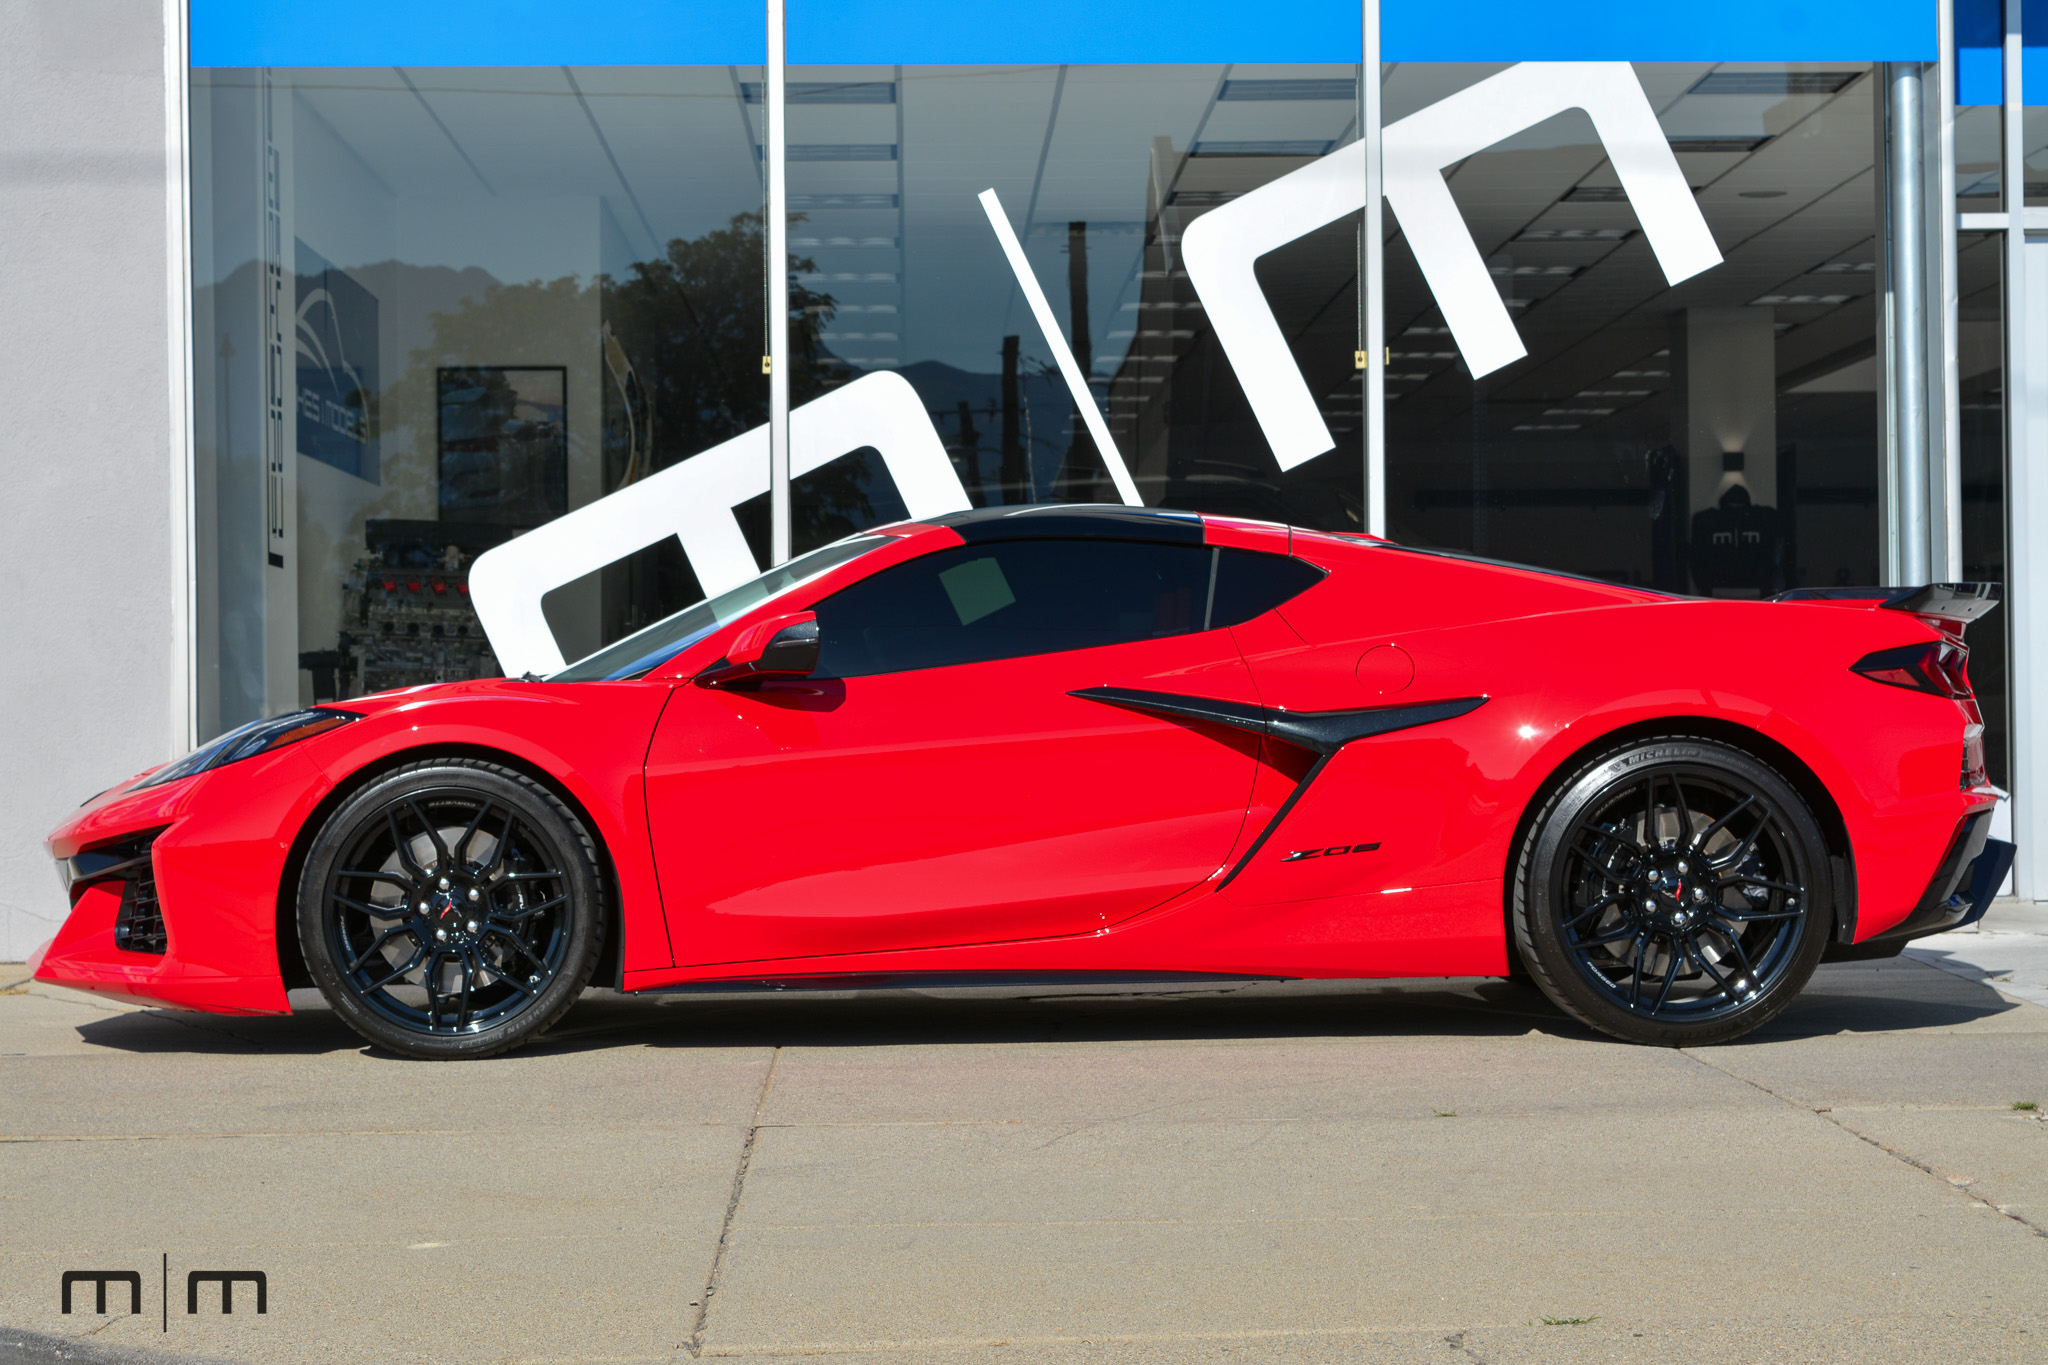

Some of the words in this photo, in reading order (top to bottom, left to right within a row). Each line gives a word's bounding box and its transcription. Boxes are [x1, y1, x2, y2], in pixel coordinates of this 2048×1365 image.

[1628, 747, 1698, 766] MICHELIN
[428, 800, 476, 809] CORVETTE
[1280, 842, 1382, 862] Z06
[340, 915, 351, 951] FORGED
[1586, 961, 1617, 989] FORGED
[507, 992, 557, 1034] MICHELIN
